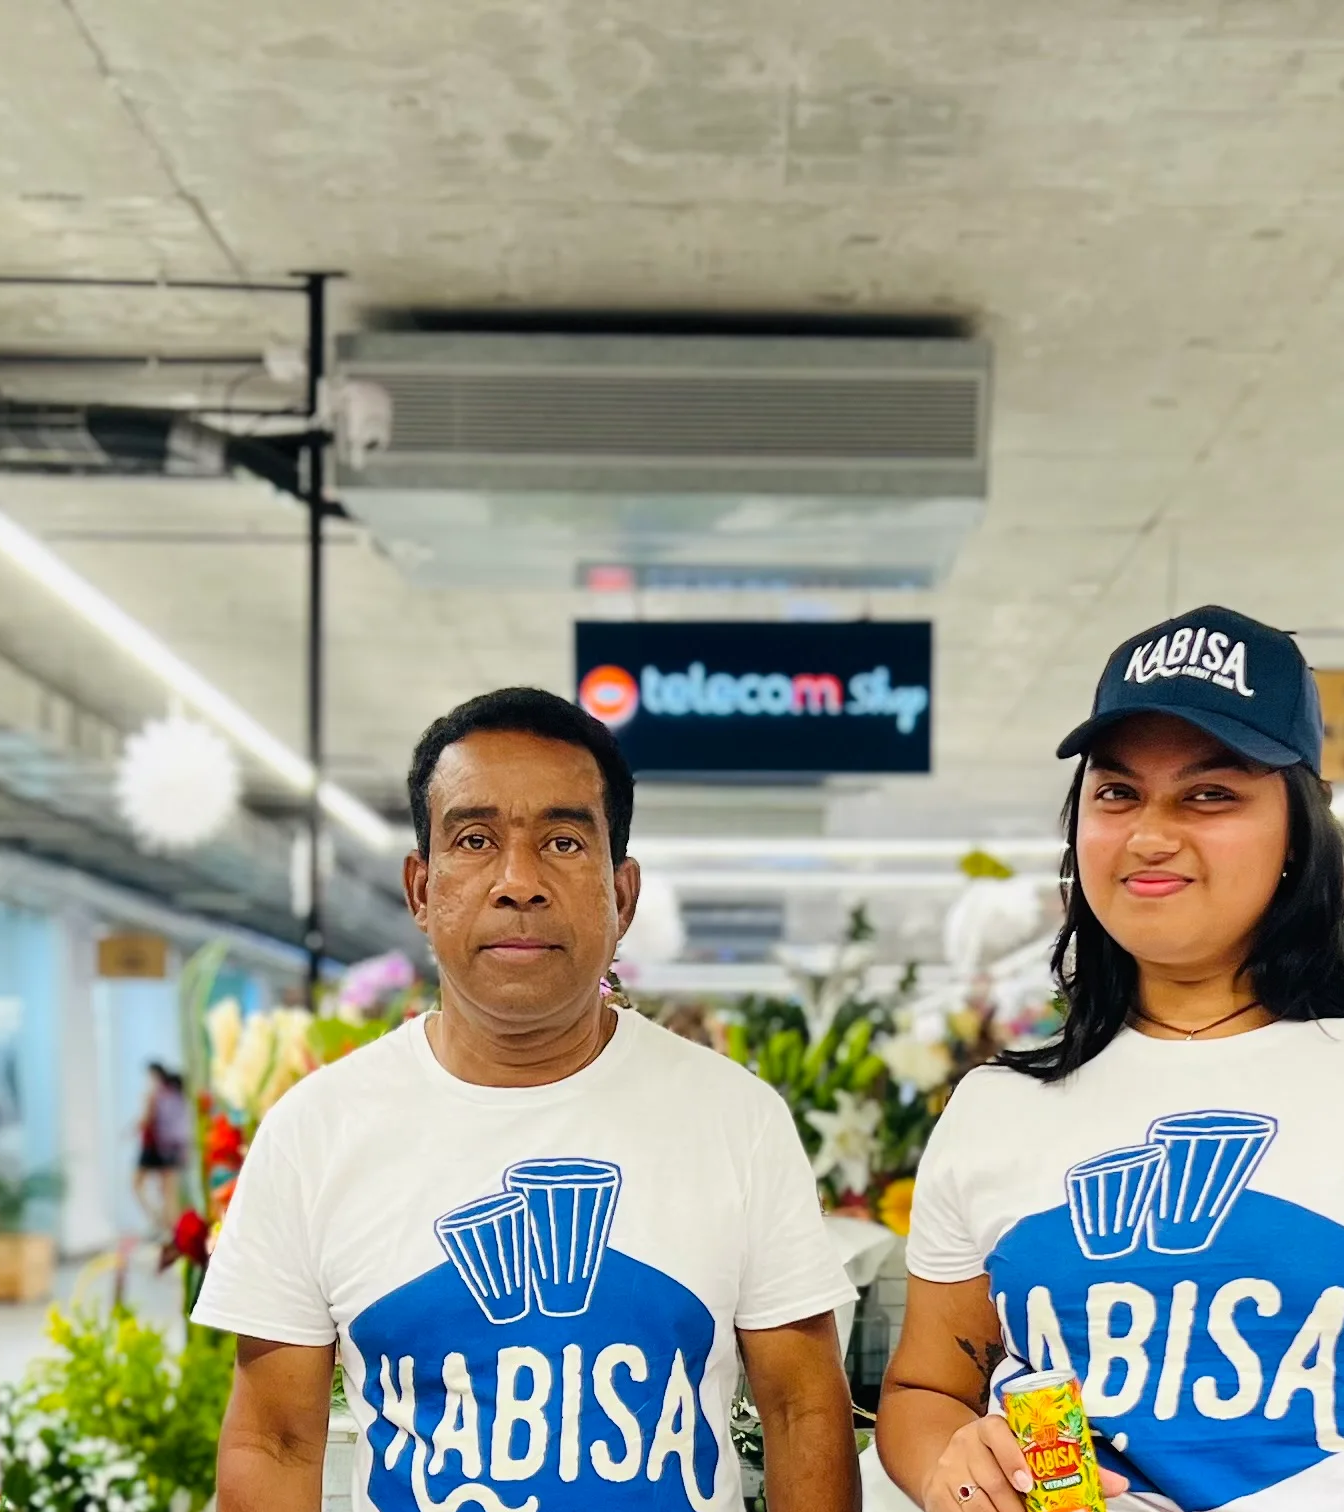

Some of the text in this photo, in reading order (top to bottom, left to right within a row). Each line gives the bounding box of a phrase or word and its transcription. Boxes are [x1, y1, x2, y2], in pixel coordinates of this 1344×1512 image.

[1124, 627, 1254, 697] KABISA
[641, 661, 843, 715] telecom
[1025, 1445, 1080, 1477] KABISA
[1043, 1475, 1080, 1490] VITAMIN
